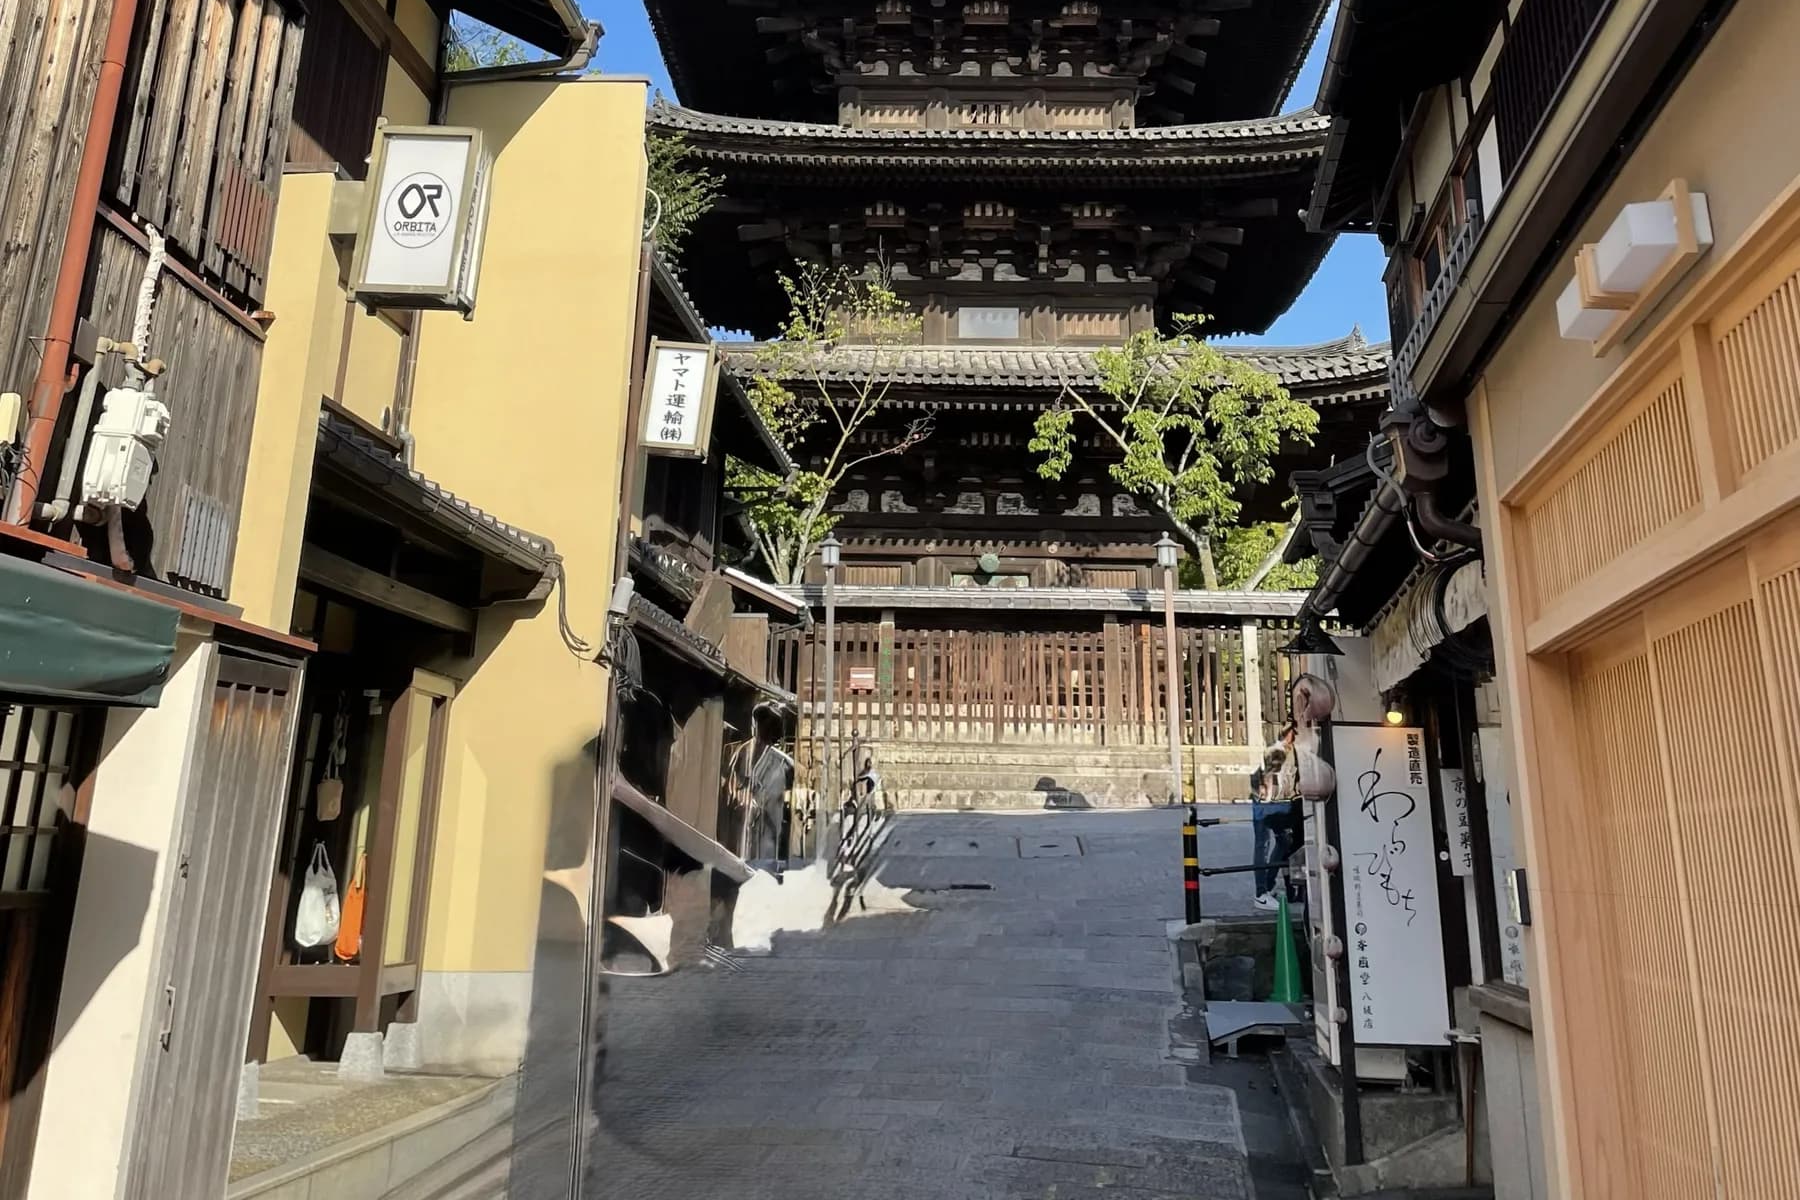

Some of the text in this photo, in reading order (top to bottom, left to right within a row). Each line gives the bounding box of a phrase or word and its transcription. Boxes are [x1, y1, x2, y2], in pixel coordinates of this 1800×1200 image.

[393, 221, 437, 232] ORBITA
[660, 352, 692, 441] ヤマト運輸(株)
[1406, 733, 1423, 785] 製造直売
[1352, 747, 1416, 927] わらびもち
[1451, 776, 1472, 868] 京の豆菓子
